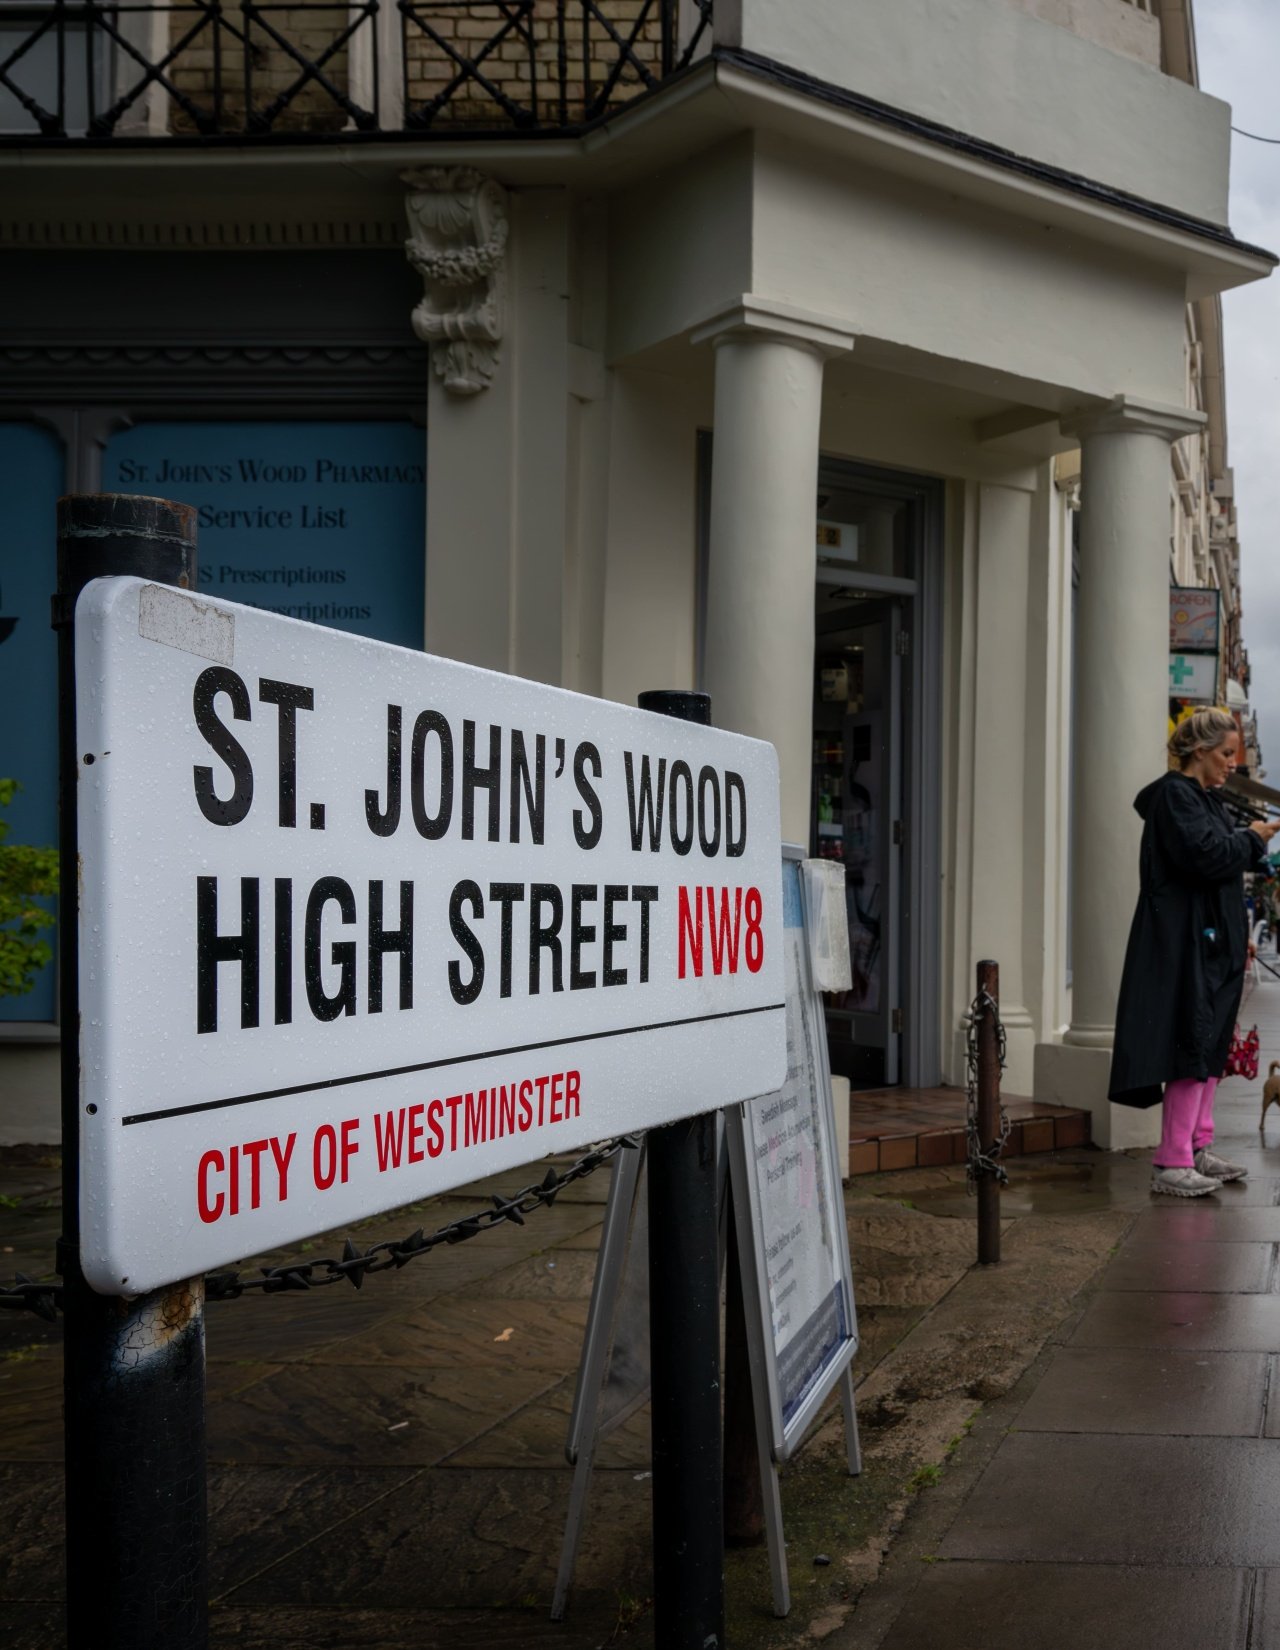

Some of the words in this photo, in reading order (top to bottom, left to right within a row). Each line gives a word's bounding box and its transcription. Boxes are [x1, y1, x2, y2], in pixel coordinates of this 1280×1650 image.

[198, 504, 293, 529] Service
[300, 504, 348, 529] List
[219, 565, 347, 588] Prescriptions
[193, 666, 326, 830] ST.
[364, 704, 603, 850] JOHN'S
[623, 751, 747, 858] WOOD
[196, 875, 415, 1034] HIGH
[448, 879, 659, 1005] STREET
[677, 885, 764, 980] NW8
[197, 1133, 298, 1224] CITY
[312, 1116, 360, 1192] OF
[373, 1069, 582, 1172] WESTMINSTER
